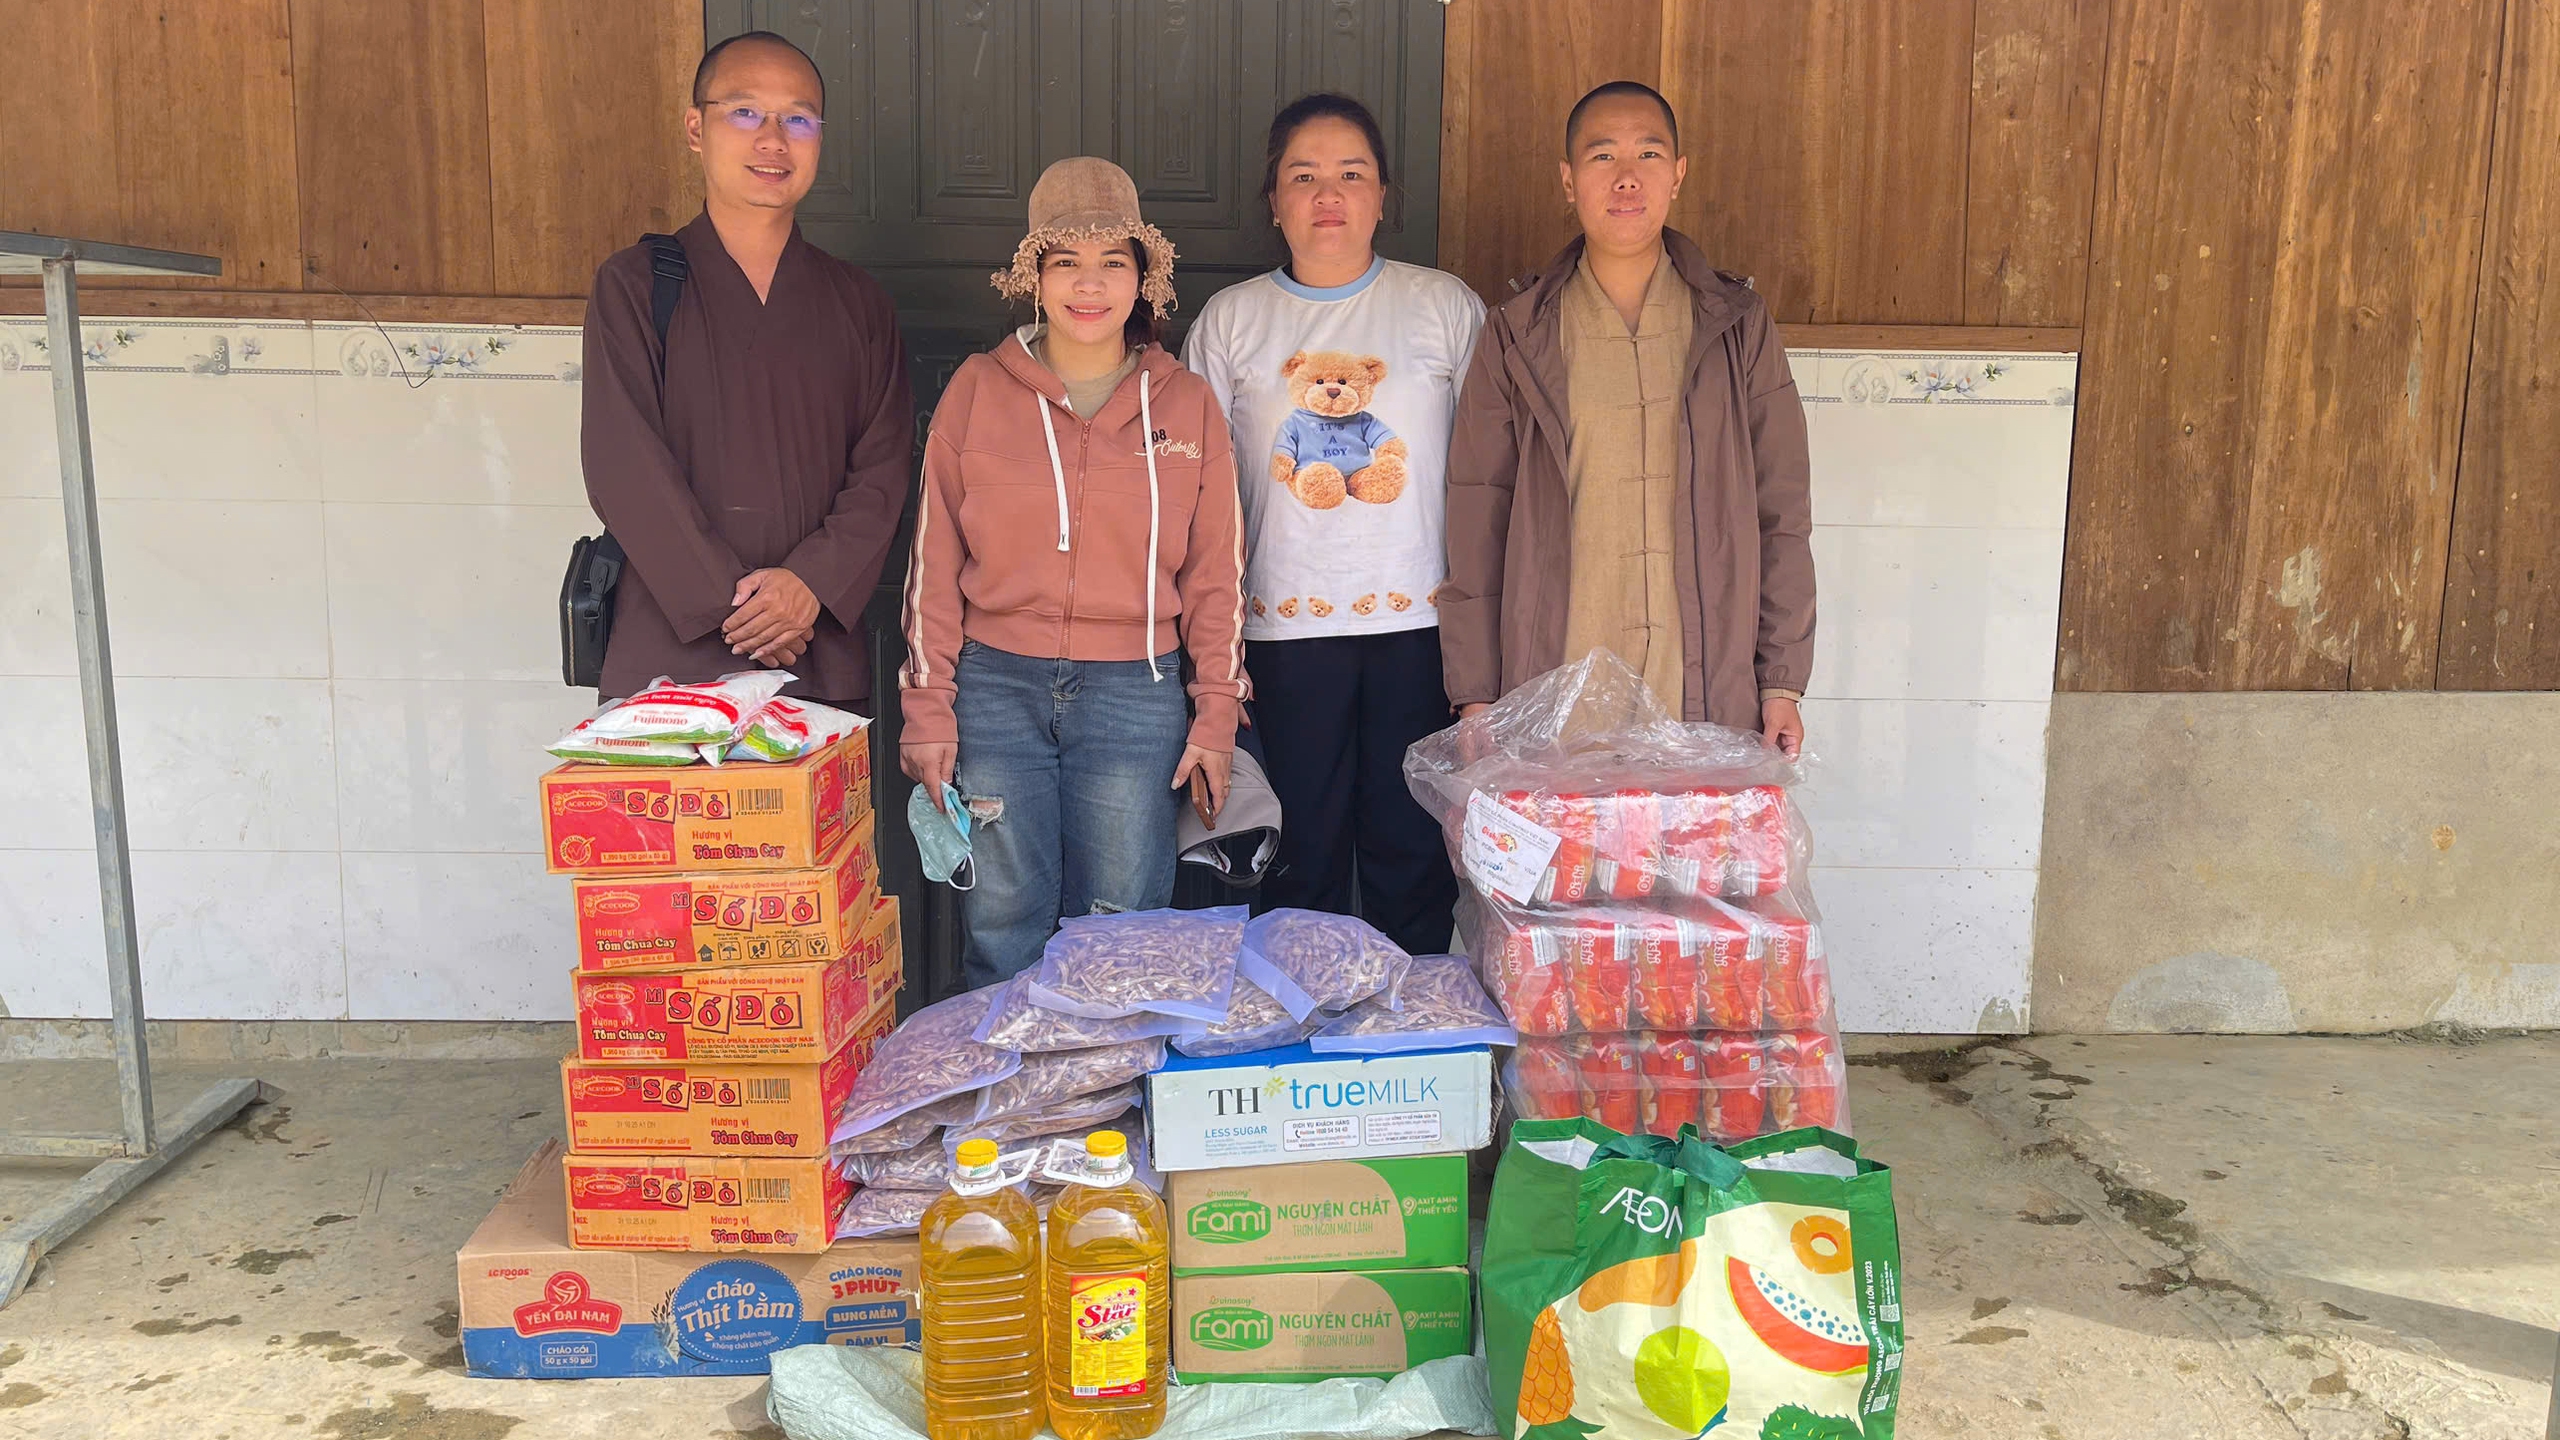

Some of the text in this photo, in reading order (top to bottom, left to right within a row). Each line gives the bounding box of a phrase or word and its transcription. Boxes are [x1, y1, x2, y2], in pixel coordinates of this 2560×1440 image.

[1318, 422, 1345, 432] IT'S
[1328, 435, 1338, 445] A
[1322, 448, 1348, 458] BOY
[633, 714, 689, 726] Fujimono
[595, 736, 651, 748] Fujimono
[627, 791, 725, 818] Số Đỏ
[692, 830, 733, 841] Hương vị
[693, 843, 785, 860] Tôm Chua Cay
[1567, 864, 1586, 898] Oishi
[672, 892, 814, 926] Mì Số Đỏ
[597, 937, 677, 952] Tôm Chua Cay
[1581, 929, 1596, 965] Oishi
[1646, 928, 1661, 965] Oishi
[1714, 934, 1731, 967] Oishi
[1775, 930, 1790, 965] Oishi
[1507, 940, 1522, 975] Oishi
[646, 988, 794, 1026] Mì Số Đỏ
[593, 1029, 667, 1043] Tôm Chua Cay
[643, 1079, 683, 1104] Số
[693, 1081, 736, 1104] Đỏ
[1208, 1087, 1262, 1116] TH
[711, 1117, 750, 1128] Hương vị
[711, 1130, 798, 1147] Tôm Chua Cay
[1205, 1125, 1268, 1138] LESS SUGAR
[643, 1178, 736, 1204] Số Đỏ
[1277, 1194, 1390, 1220] NGUYÊN CHẤT
[1403, 1196, 1457, 1216] 9 AXIT AMIN
[1417, 1205, 1457, 1215] THIẾT YẾU
[711, 1215, 738, 1226] Hương
[1292, 1221, 1373, 1236] THƠM NGON MÁT LÀNH
[711, 1229, 798, 1246] Tôm Chua Cay
[488, 1268, 531, 1277] LC FOODS
[829, 1266, 902, 1282] CHÁO NGON
[1865, 1261, 1874, 1284] V.2023
[706, 1278, 756, 1300] cháo
[831, 1277, 901, 1299] 3 PHÚT
[1865, 1285, 1875, 1300] LỚN
[677, 1300, 699, 1312] Hương
[681, 1292, 795, 1333] Thịt bằm
[833, 1305, 898, 1322] BUNG MỀM
[1867, 1301, 1876, 1316] CÂY
[525, 1308, 611, 1324] YẾN ĐẠI NAM
[1078, 1305, 1136, 1328] Star
[1279, 1306, 1392, 1329] NGUYÊN CHẤT
[1404, 1311, 1418, 1330] 9
[1419, 1320, 1459, 1329] THIẾT YẾU
[1868, 1317, 1879, 1335] TRÁI
[1295, 1333, 1374, 1348] THƠM NGON MÁT LÀNH
[547, 1345, 589, 1355] CHÁO GÓI
[545, 1357, 555, 1365] 50
[580, 1356, 592, 1365] gói
